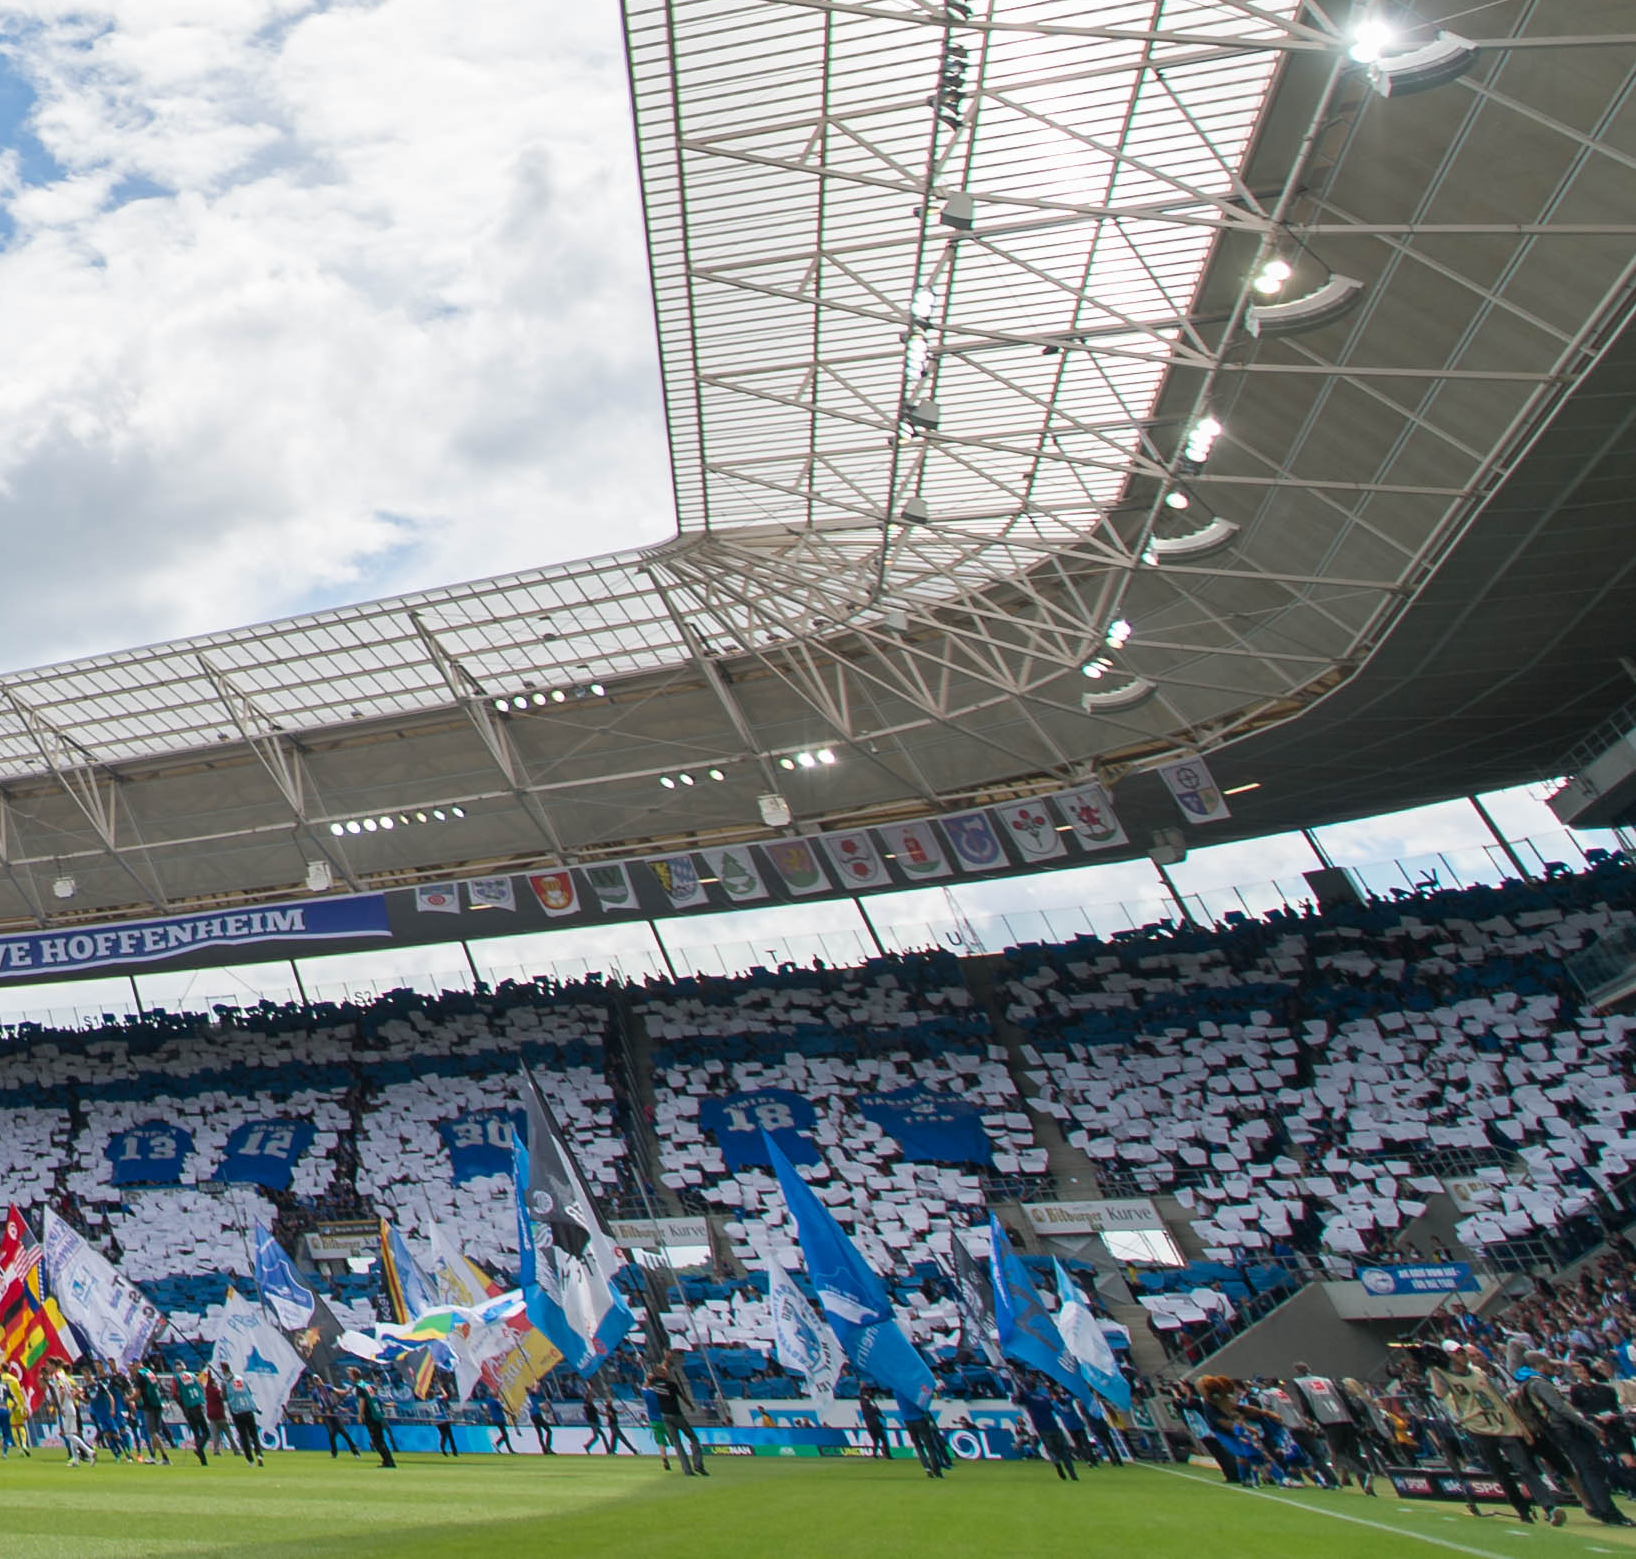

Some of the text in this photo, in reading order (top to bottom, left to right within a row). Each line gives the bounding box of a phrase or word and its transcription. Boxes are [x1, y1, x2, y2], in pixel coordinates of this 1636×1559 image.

[42, 909, 306, 963] HOFFENHEIM
[945, 931, 962, 946] U
[765, 950, 777, 964] T
[726, 1103, 795, 1132] 18
[120, 1135, 178, 1161] 13
[238, 1131, 294, 1160] 12
[1104, 1203, 1154, 1221] Kurve
[669, 1223, 707, 1238] Kurve
